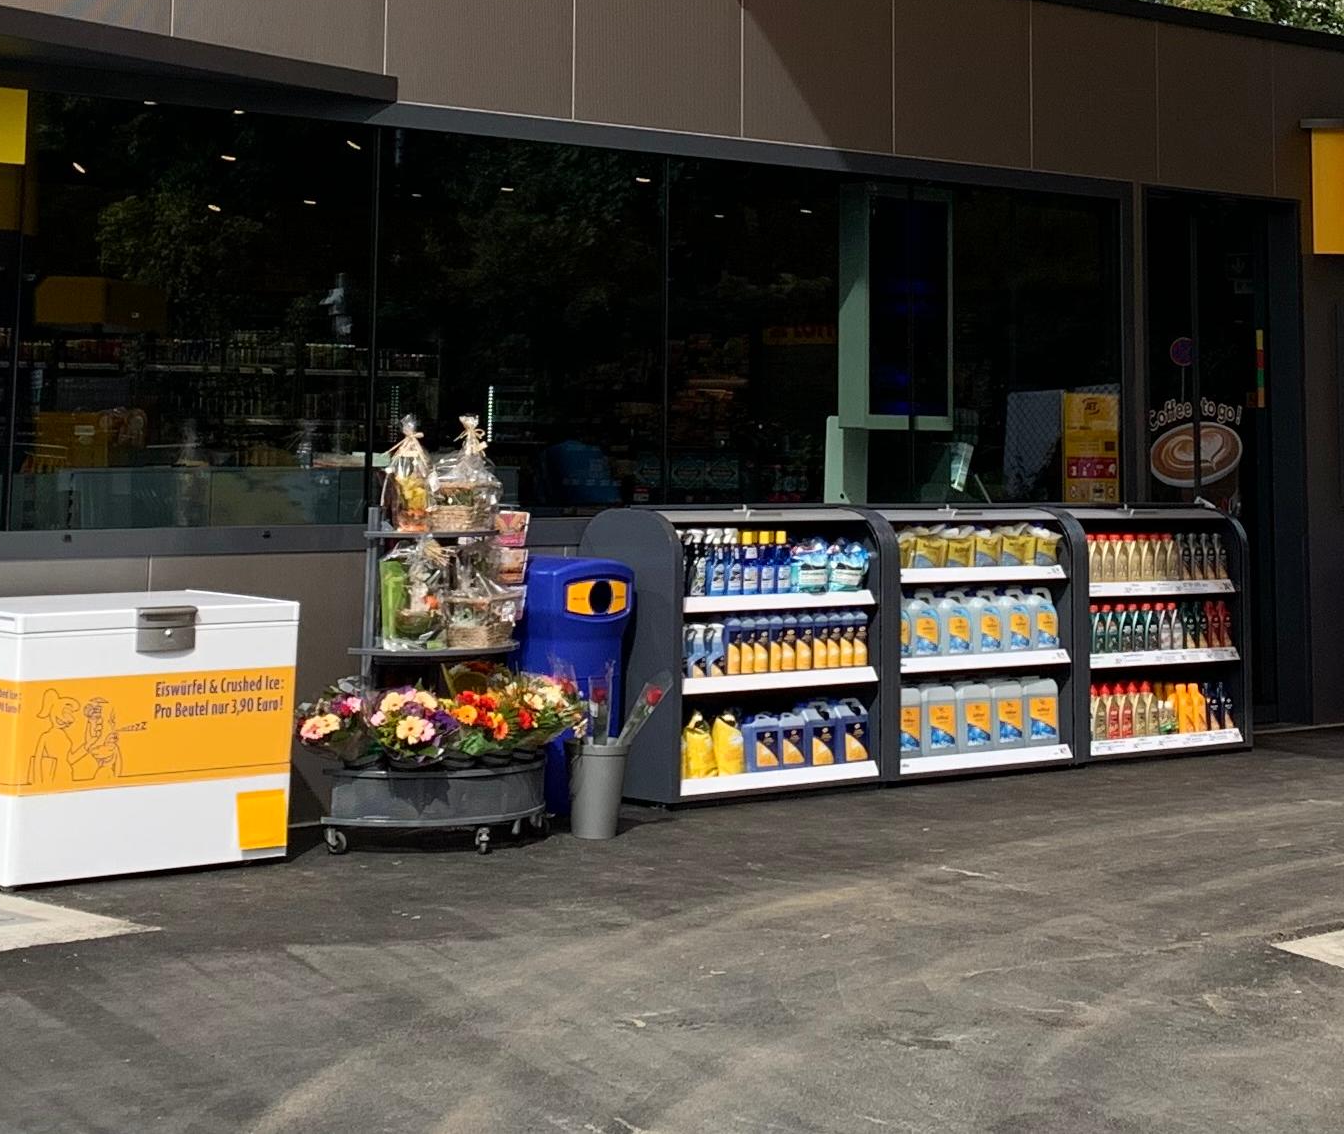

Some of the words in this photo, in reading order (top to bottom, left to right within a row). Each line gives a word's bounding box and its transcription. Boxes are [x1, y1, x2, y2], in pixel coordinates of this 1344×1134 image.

[1148, 398, 1194, 432] Coffee
[1200, 396, 1217, 417] to
[155, 678, 207, 697] Eiswürfel
[209, 679, 218, 694] &
[221, 675, 263, 694] Crushed
[265, 675, 285, 691] Ice:
[154, 703, 172, 720] Pro
[175, 700, 208, 718] Beutel
[211, 702, 230, 715] nur
[231, 697, 254, 717] 3,90
[256, 696, 284, 713] Euro!
